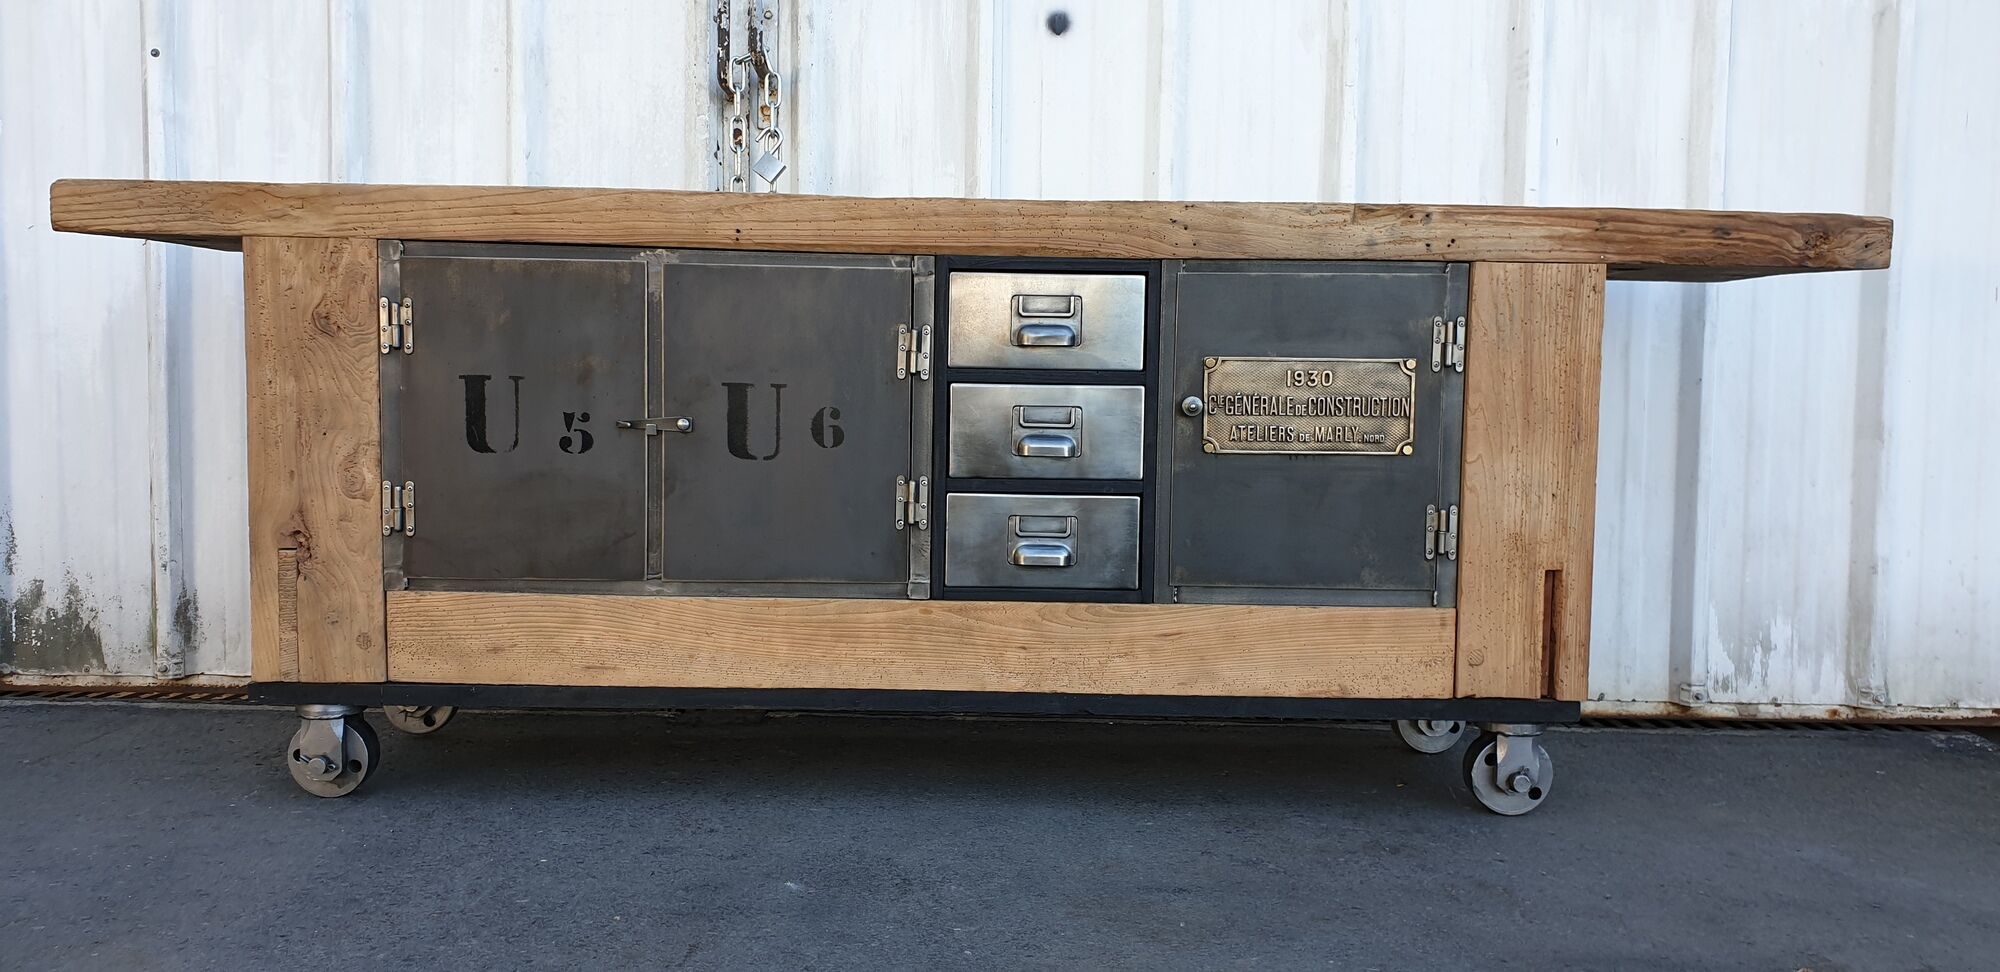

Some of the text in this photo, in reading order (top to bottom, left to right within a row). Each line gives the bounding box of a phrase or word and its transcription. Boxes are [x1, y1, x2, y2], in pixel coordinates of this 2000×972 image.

[1286, 370, 1334, 388] 1930
[458, 374, 594, 454] U 5
[1225, 392, 1294, 417] GÉNÉRALE
[1295, 404, 1308, 416] DE
[1308, 396, 1410, 417] CONSTRUCTION
[721, 382, 845, 461] U 6
[1230, 425, 1294, 443] ATELIERS
[1299, 433, 1311, 443] DE
[1363, 433, 1385, 443] NORD
